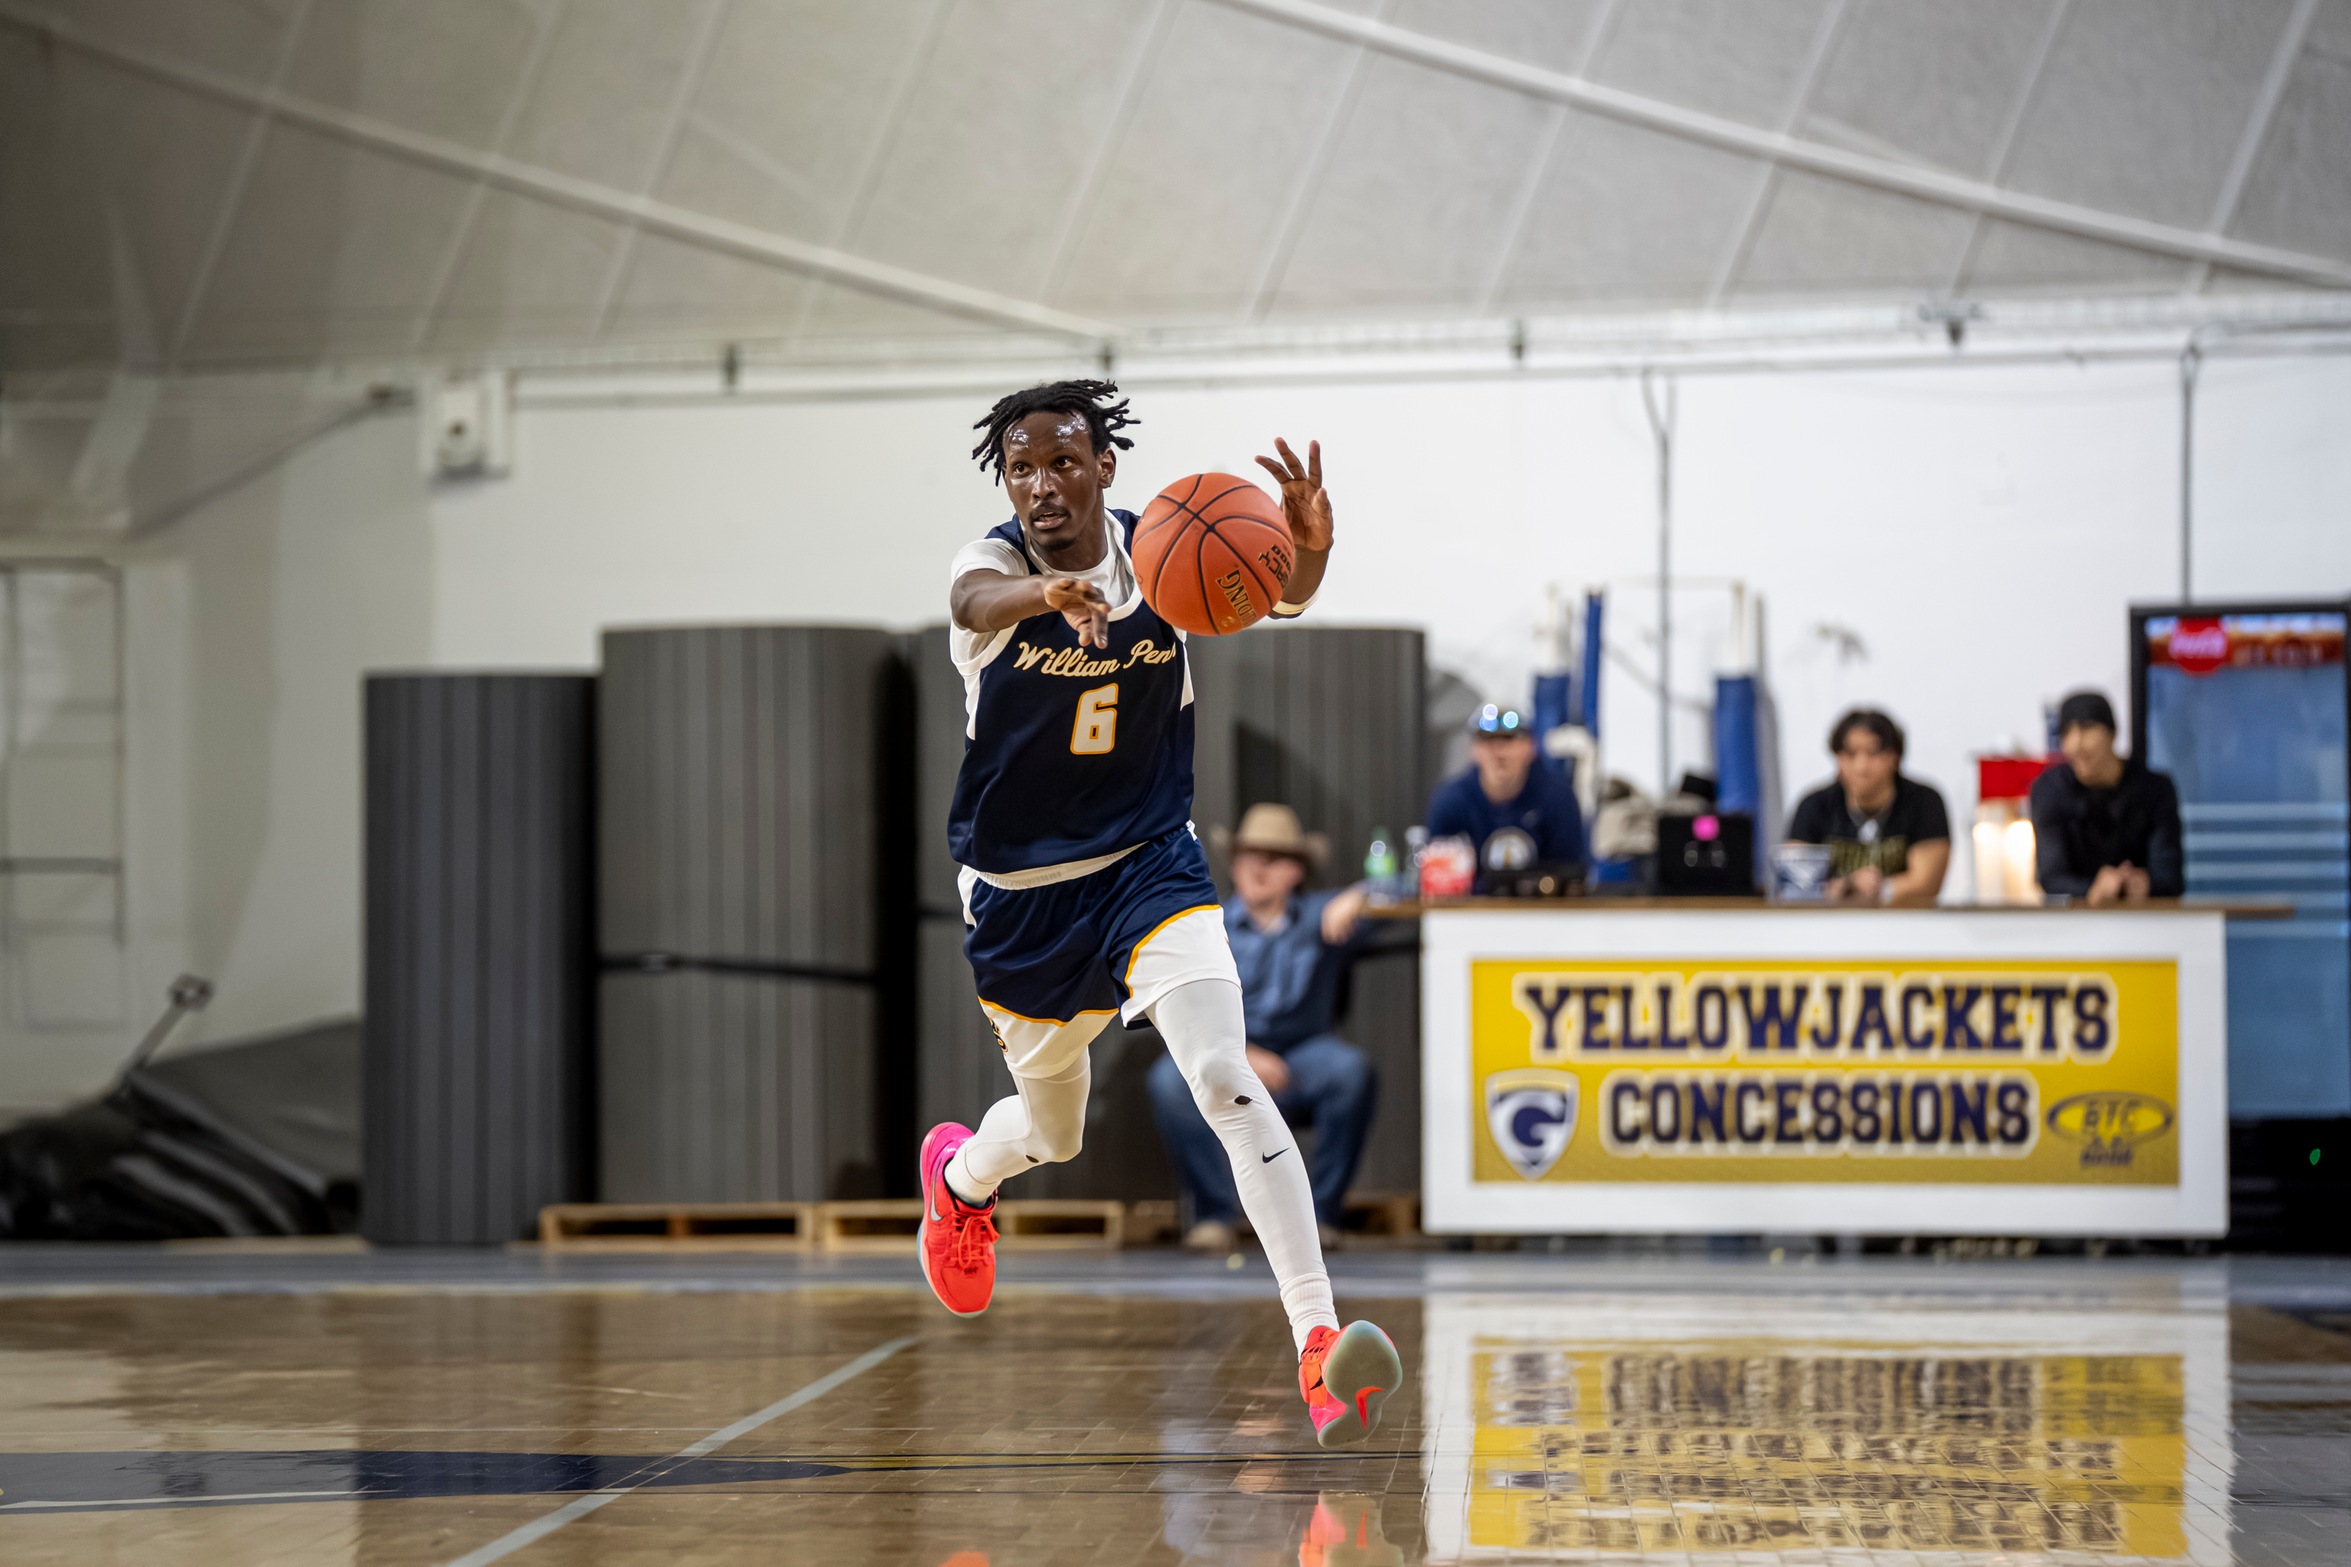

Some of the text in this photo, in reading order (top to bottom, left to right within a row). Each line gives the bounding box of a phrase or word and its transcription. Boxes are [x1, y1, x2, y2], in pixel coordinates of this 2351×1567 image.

[1216, 569, 1259, 626] LDING
[1013, 641, 1120, 677] William
[1070, 683, 1119, 755] 6
[1518, 978, 2114, 1057] YELLOWJACKETS
[1605, 1075, 2034, 1150] CONCESSIONS
